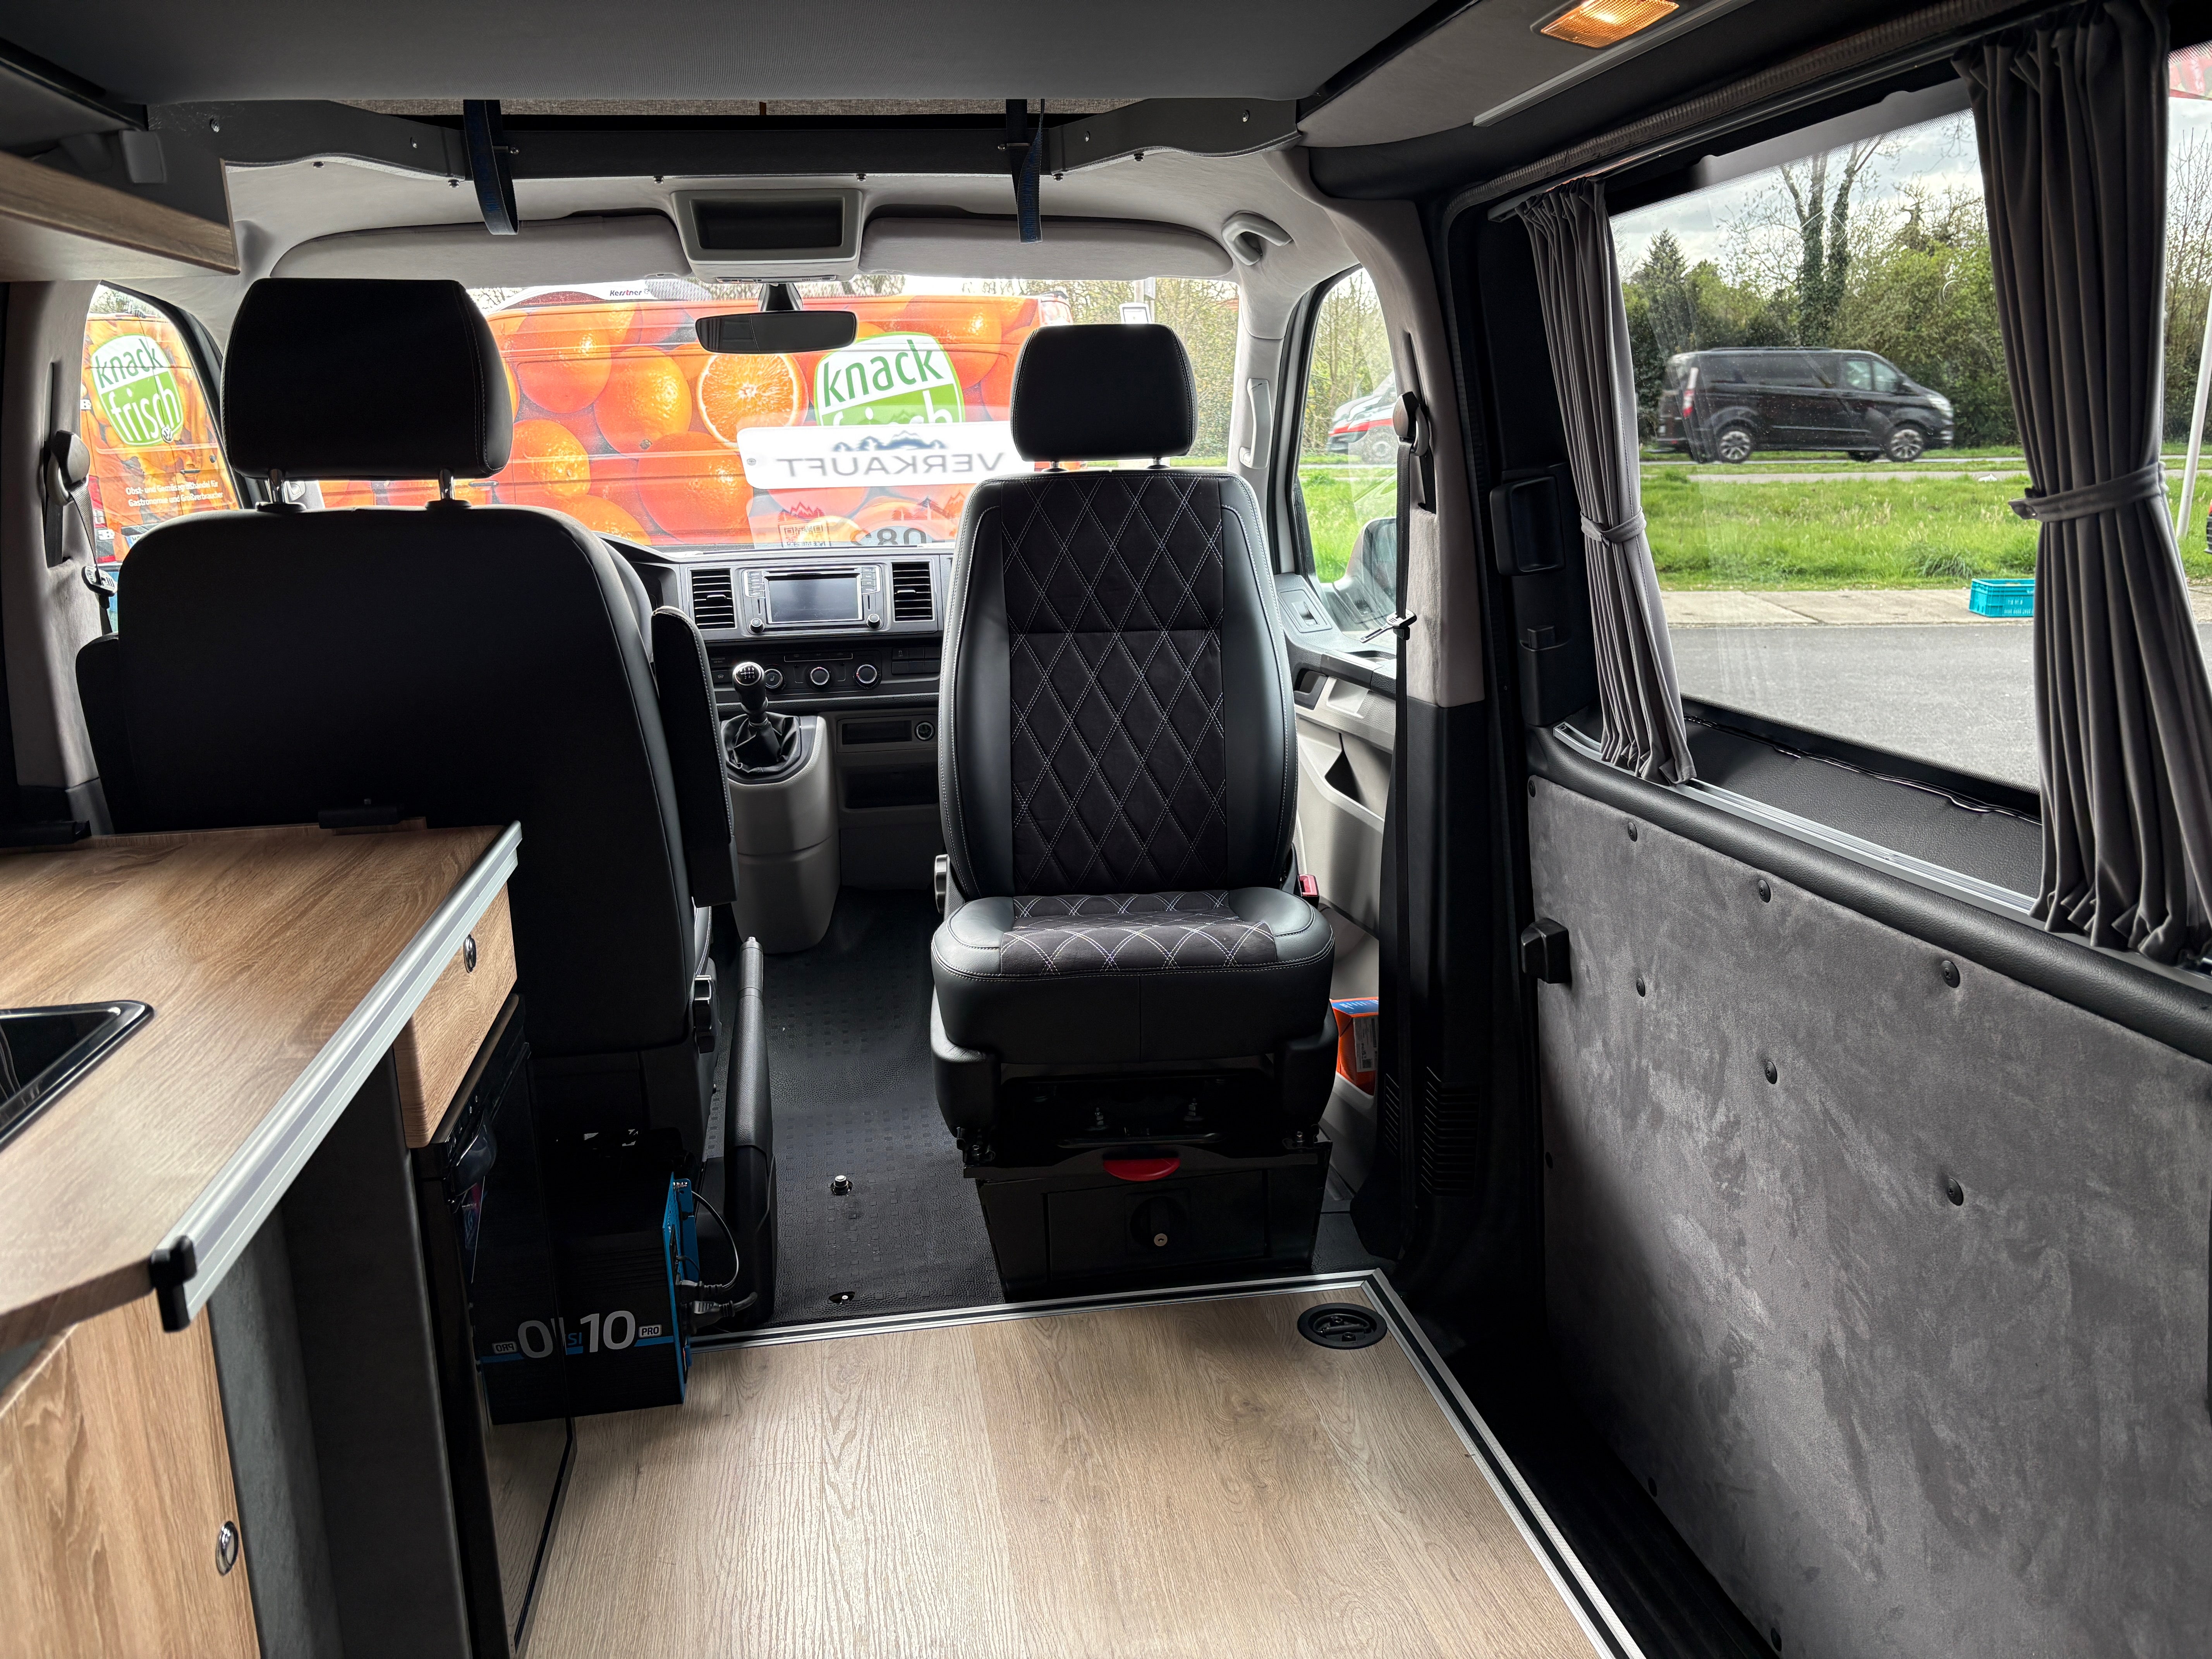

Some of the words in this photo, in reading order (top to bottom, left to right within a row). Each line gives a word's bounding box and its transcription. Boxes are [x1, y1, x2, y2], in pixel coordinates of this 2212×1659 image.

[95, 338, 163, 388] knack
[824, 339, 944, 407] knack
[108, 375, 182, 441] frisch
[125, 487, 144, 495] Obst-
[128, 496, 168, 507] Gastronomie
[169, 495, 180, 503] und
[180, 492, 223, 502] Großverbraucher
[580, 1310, 636, 1353] 10
[642, 1327, 659, 1336] PRO
